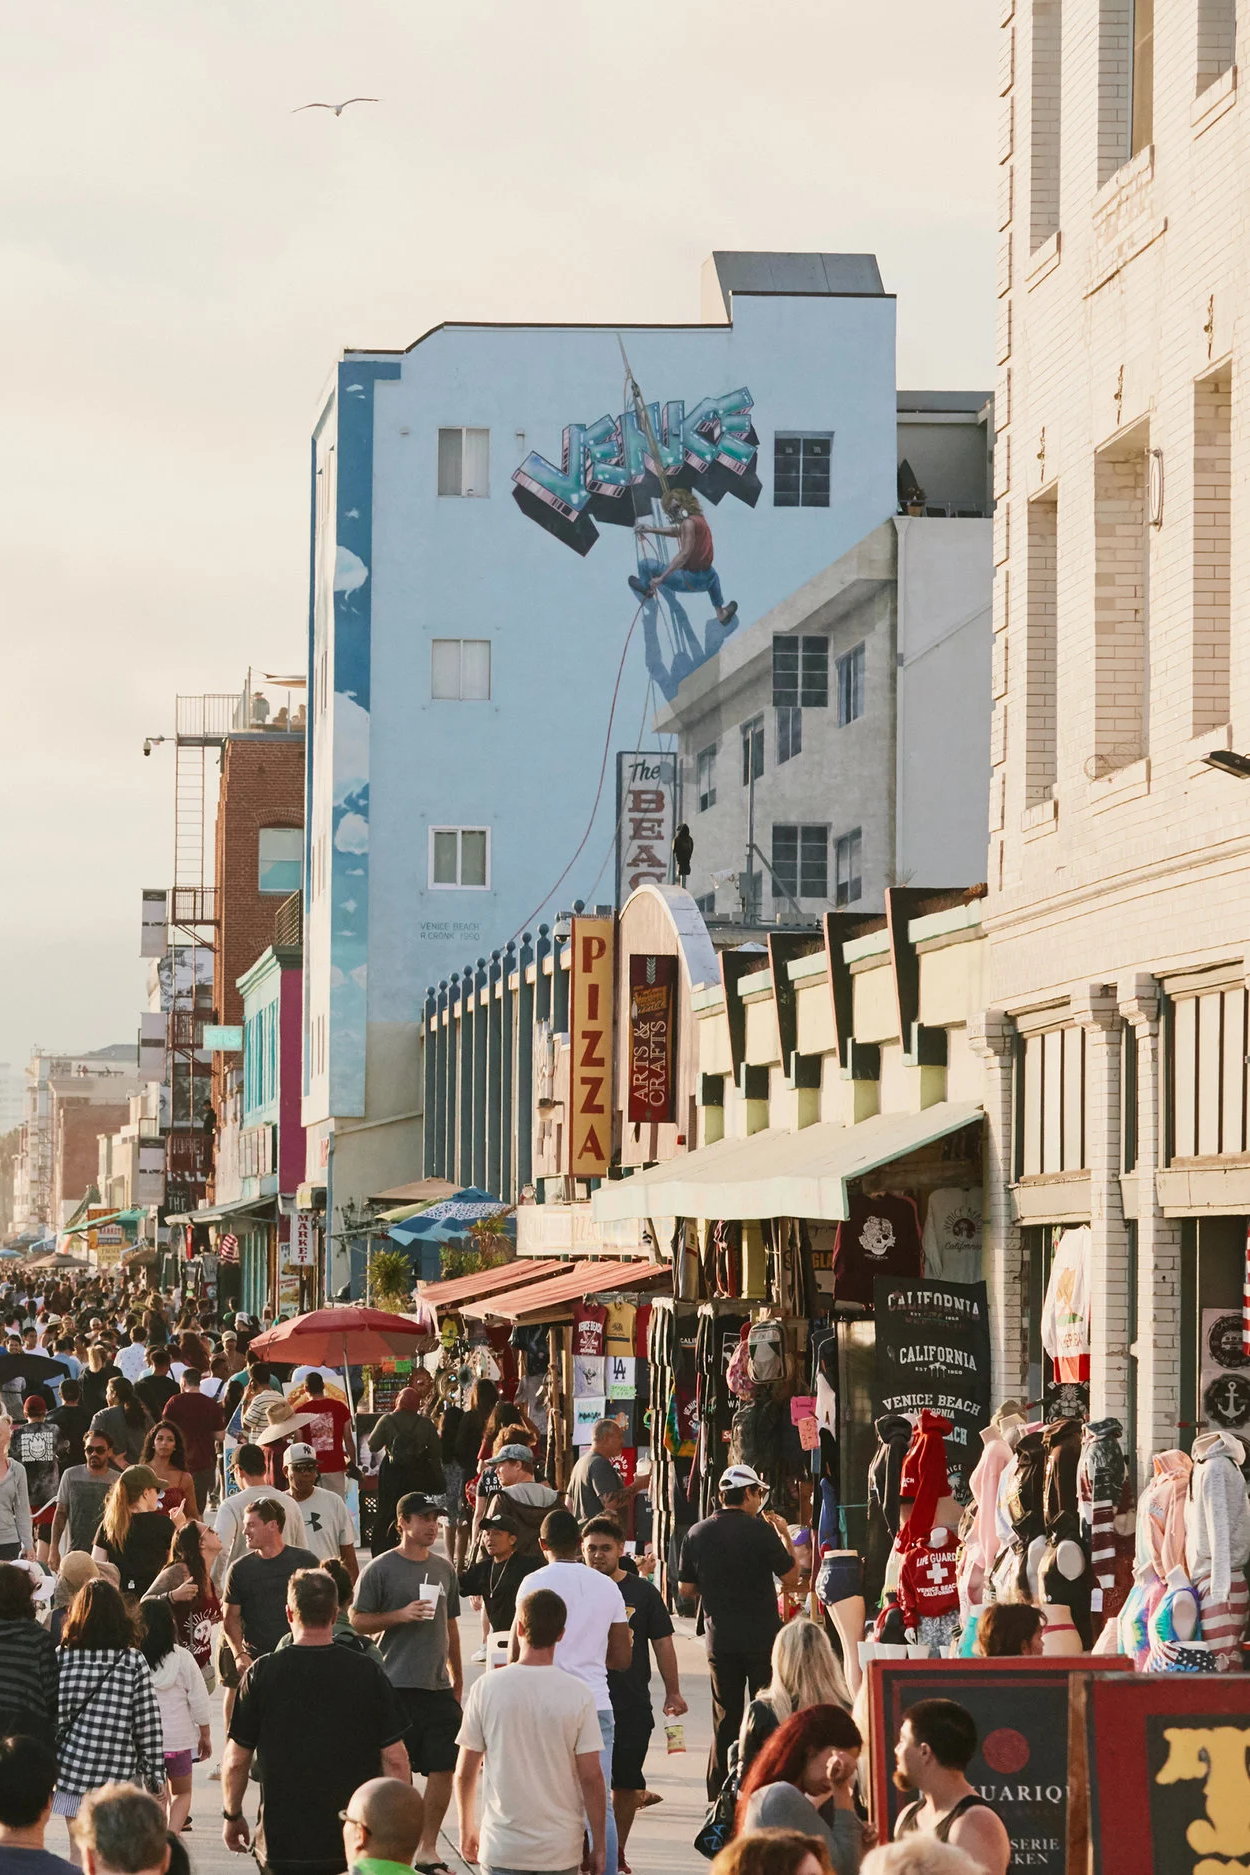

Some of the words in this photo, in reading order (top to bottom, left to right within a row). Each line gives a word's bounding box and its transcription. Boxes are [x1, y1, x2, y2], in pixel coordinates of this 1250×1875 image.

[627, 759, 661, 782] The
[626, 789, 667, 891] BEAC
[633, 1020, 650, 1039] &
[577, 935, 607, 1161] PIZZA
[633, 1044, 649, 1103] ARTS
[649, 1020, 667, 1108] CRAFTS
[297, 1214, 309, 1263] MARKET
[899, 1345, 978, 1371] CALIFORNIA
[882, 1393, 933, 1411] VENICE
[937, 1394, 981, 1417] BEACH
[907, 1407, 955, 1420] CALORNIA
[916, 1554, 929, 1568] LIFE
[930, 1552, 957, 1564] GUARD
[974, 1785, 1070, 1804] UARIQ
[1009, 1838, 1061, 1851] SERIE
[1010, 1852, 1050, 1866] KEN
